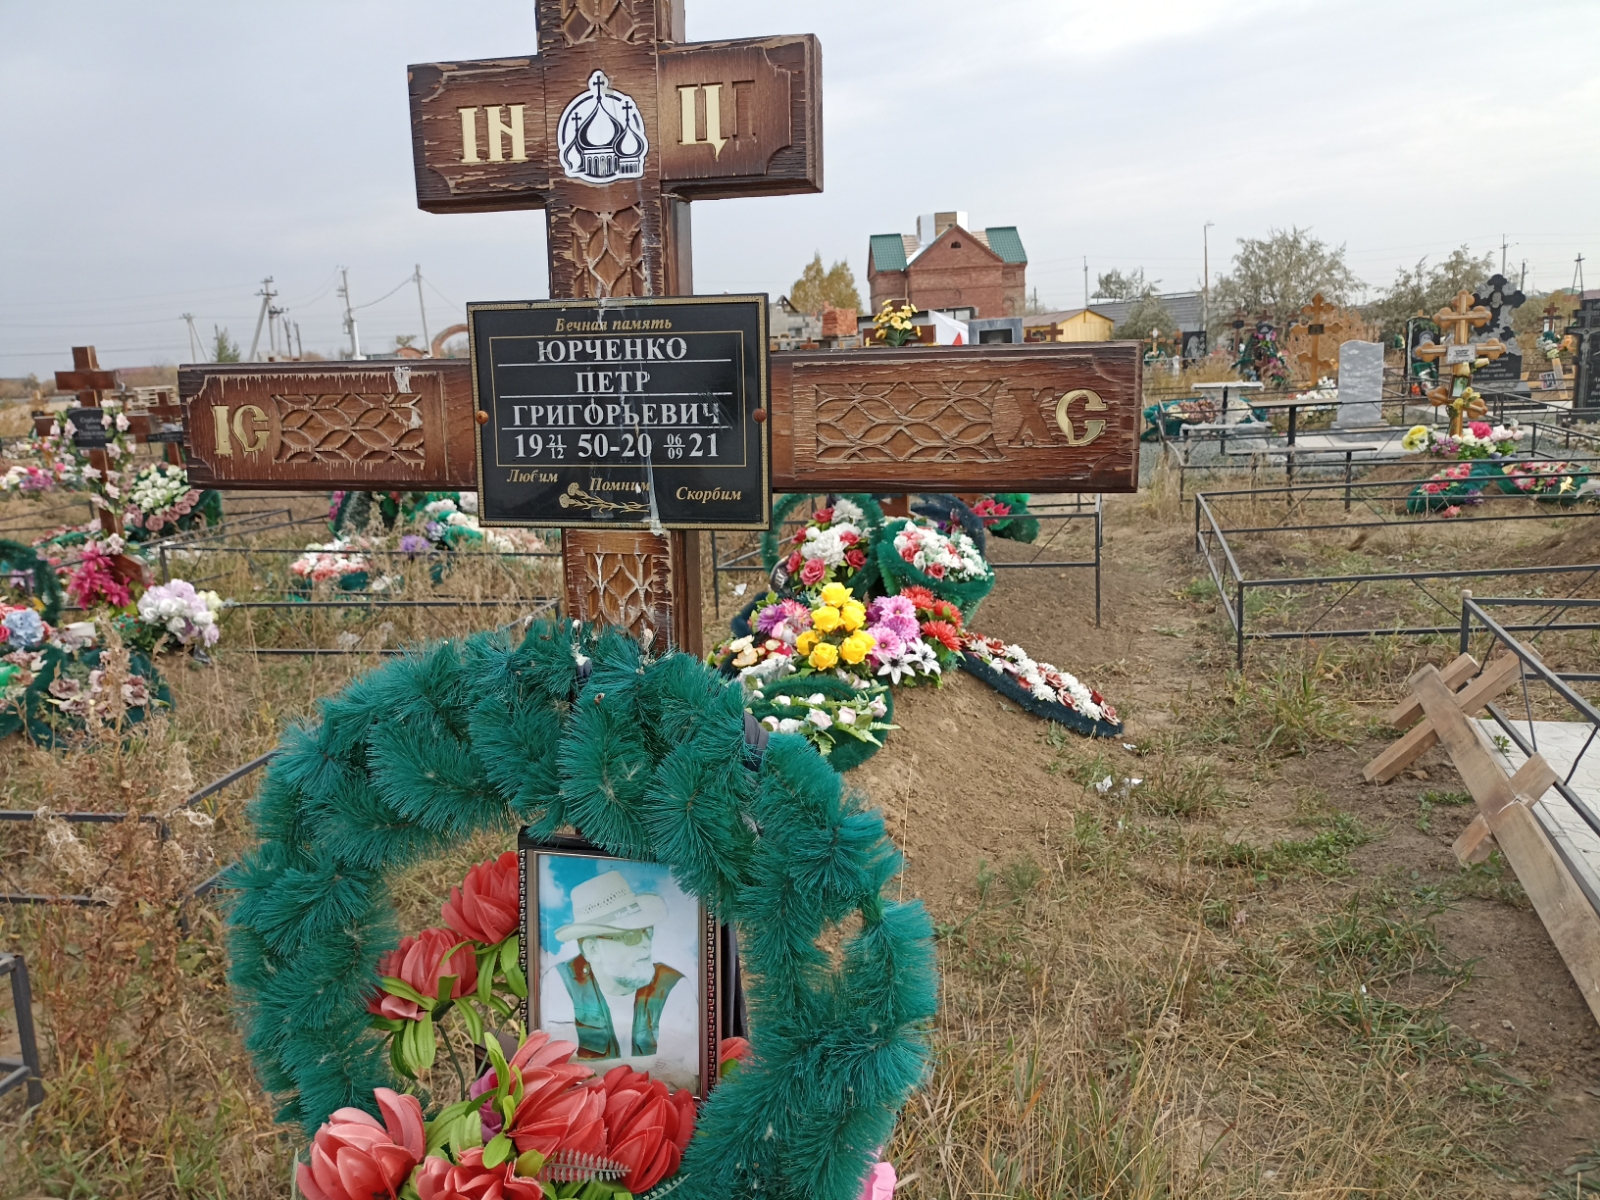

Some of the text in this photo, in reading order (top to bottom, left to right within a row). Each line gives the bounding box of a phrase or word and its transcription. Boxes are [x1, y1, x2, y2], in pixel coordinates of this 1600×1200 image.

[555, 318, 673, 332] Вечная память
[536, 337, 688, 363] ЮРЧЕНКО
[575, 371, 651, 393] ПЕТР
[512, 402, 721, 427] ГРИГОРЬЕВИЧ
[506, 469, 559, 483] Любим
[675, 486, 742, 504] Скорбим
